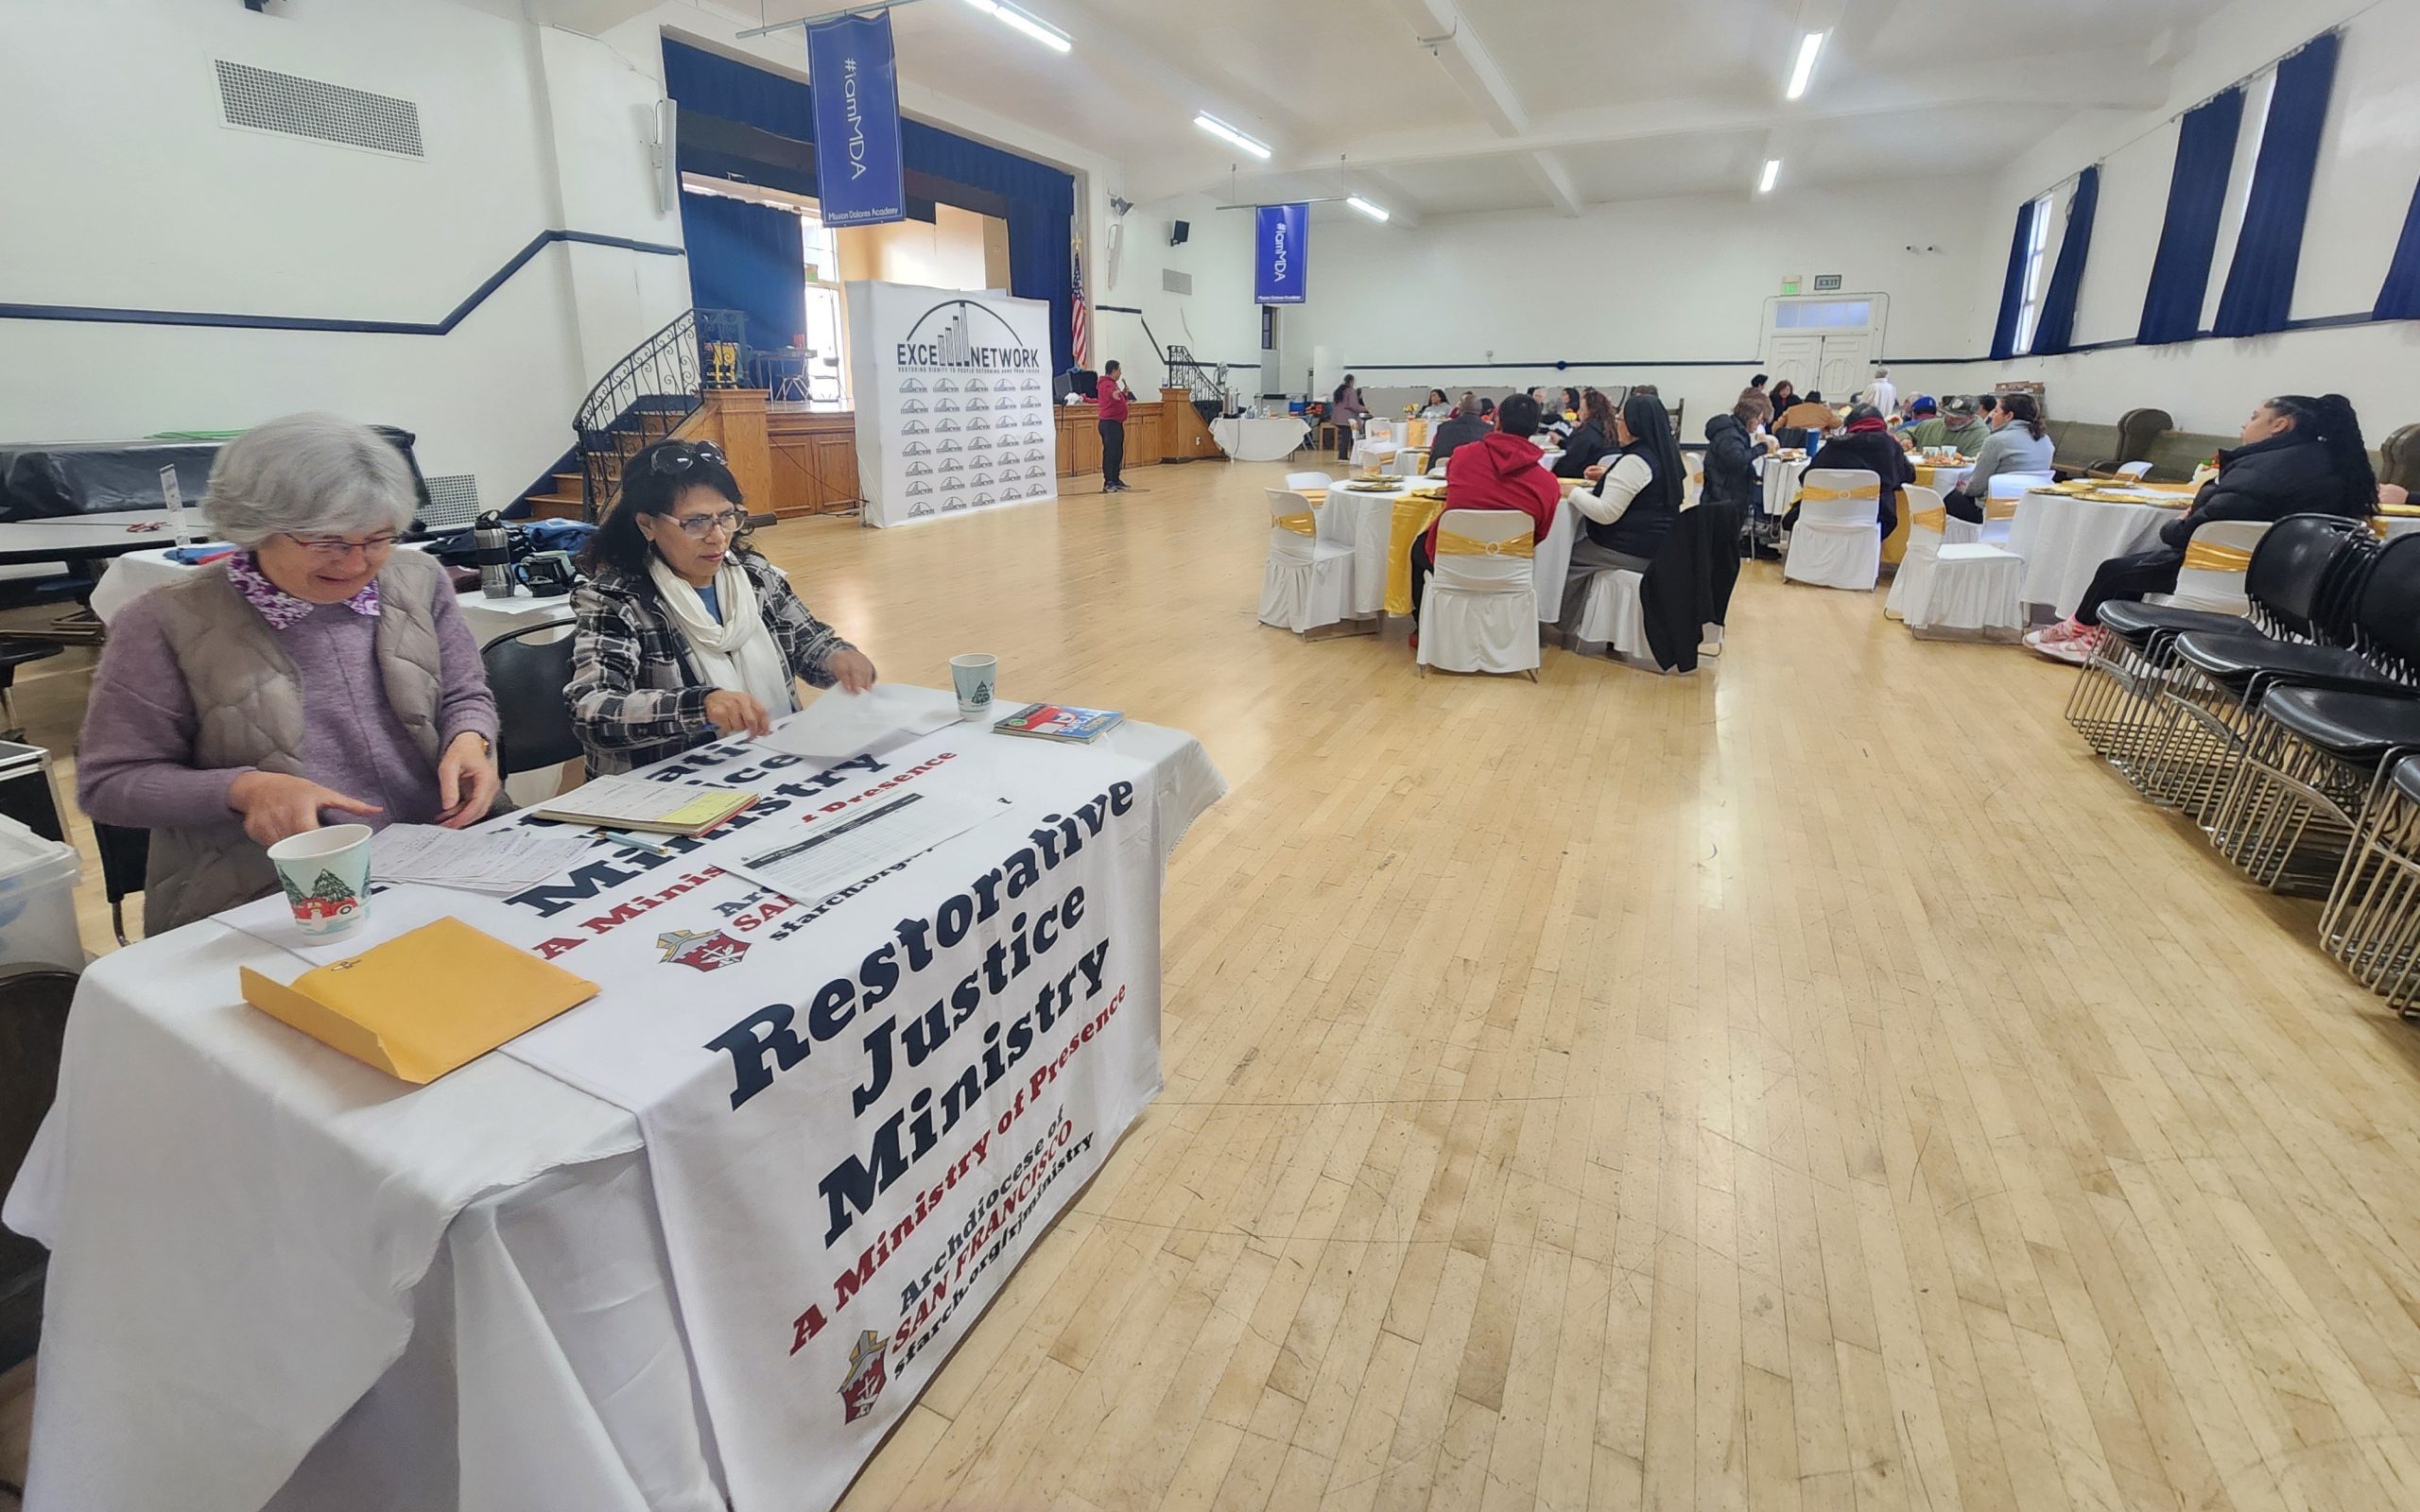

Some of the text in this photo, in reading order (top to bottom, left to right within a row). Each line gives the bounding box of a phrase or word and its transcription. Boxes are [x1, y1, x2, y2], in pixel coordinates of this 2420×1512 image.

[844, 58, 866, 180] #iamMDA
[872, 207, 899, 217] Academy
[970, 346, 1040, 369] NETWORK
[1274, 222, 1287, 283] #iamMDA
[531, 936, 589, 960] A
[577, 867, 727, 935] Minis
[703, 780, 1134, 1112] Restorative
[853, 885, 1085, 1120] Justice
[789, 984, 1127, 1357] A Ministry of Presence
[819, 938, 1110, 1250] Ministry
[891, 1119, 1073, 1355] SAN FRANCISCO
[893, 1130, 1095, 1382] sfarch.org/rjministry
[900, 1103, 1064, 1318] Archdiocese of
